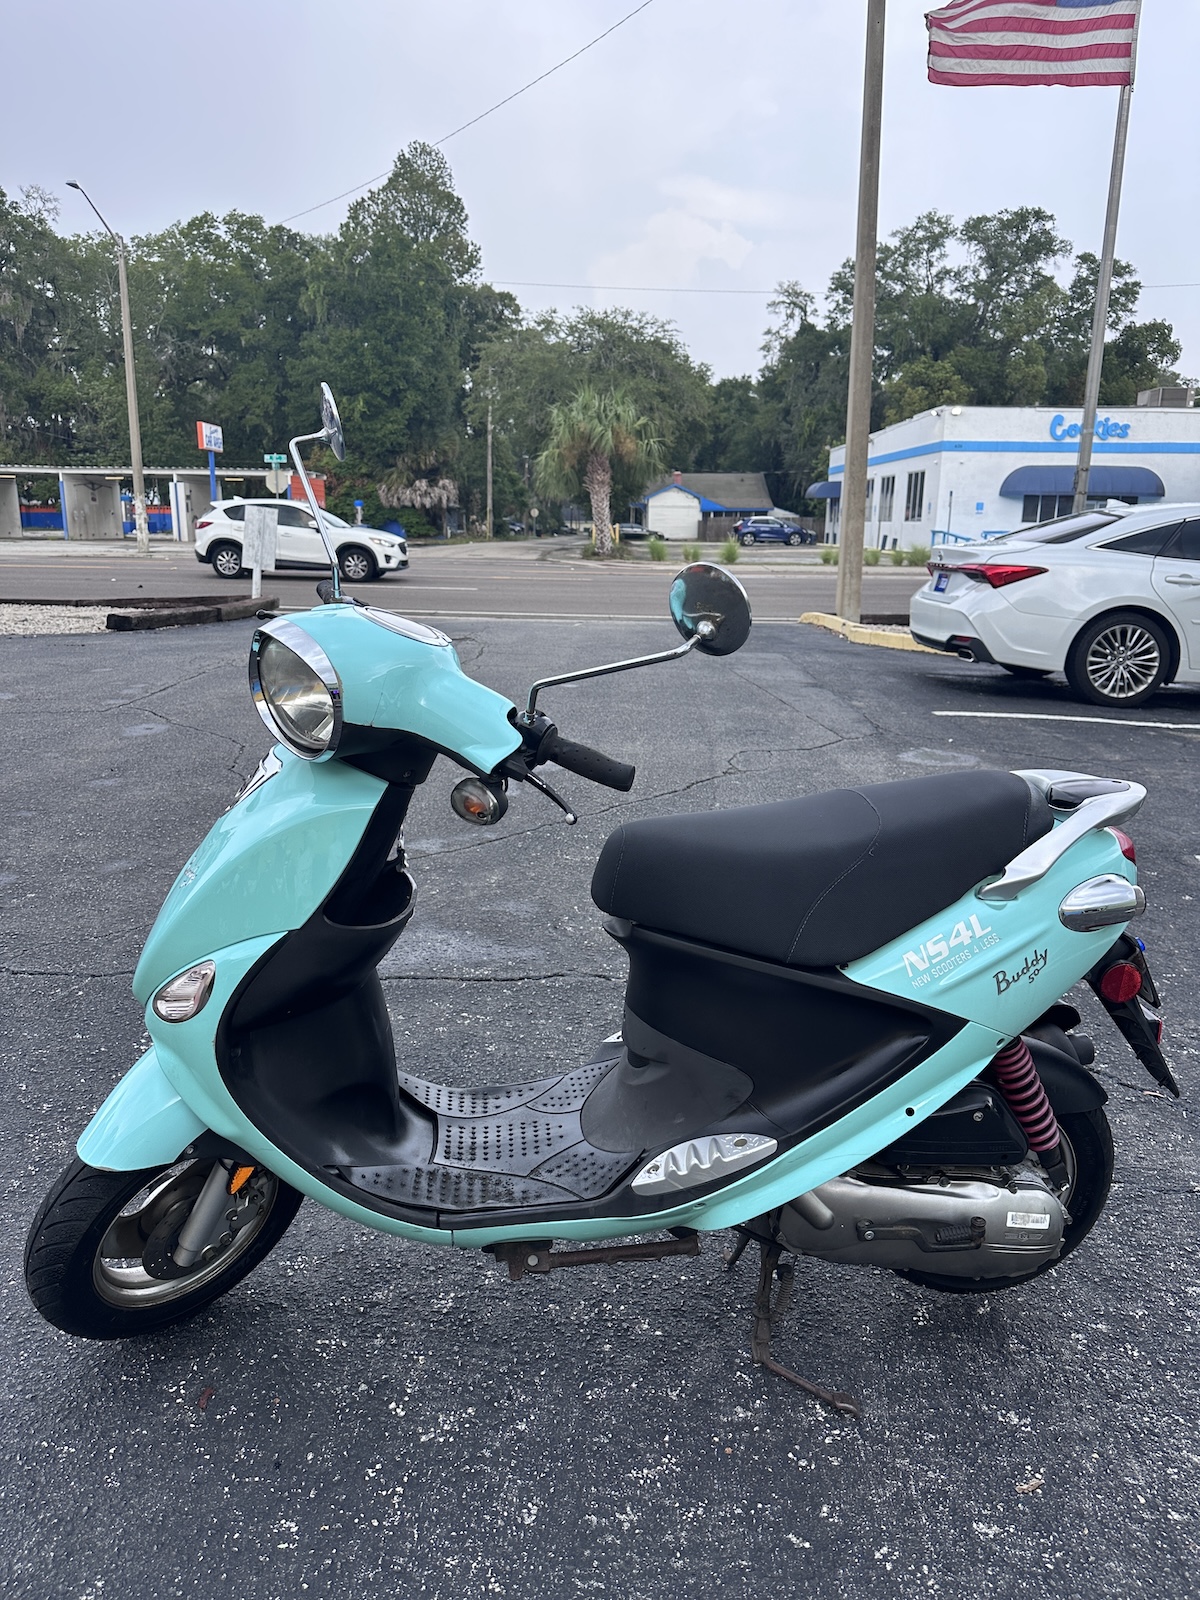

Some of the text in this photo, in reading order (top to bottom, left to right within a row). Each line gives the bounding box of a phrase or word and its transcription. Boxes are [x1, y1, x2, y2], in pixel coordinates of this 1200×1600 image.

[1050, 412, 1131, 441] Cokies
[902, 914, 992, 978] NS4L
[911, 933, 1000, 989] NEW SCOOTERS 4 LESS
[992, 948, 1048, 996] Buddy
[1028, 968, 1040, 984] 50
